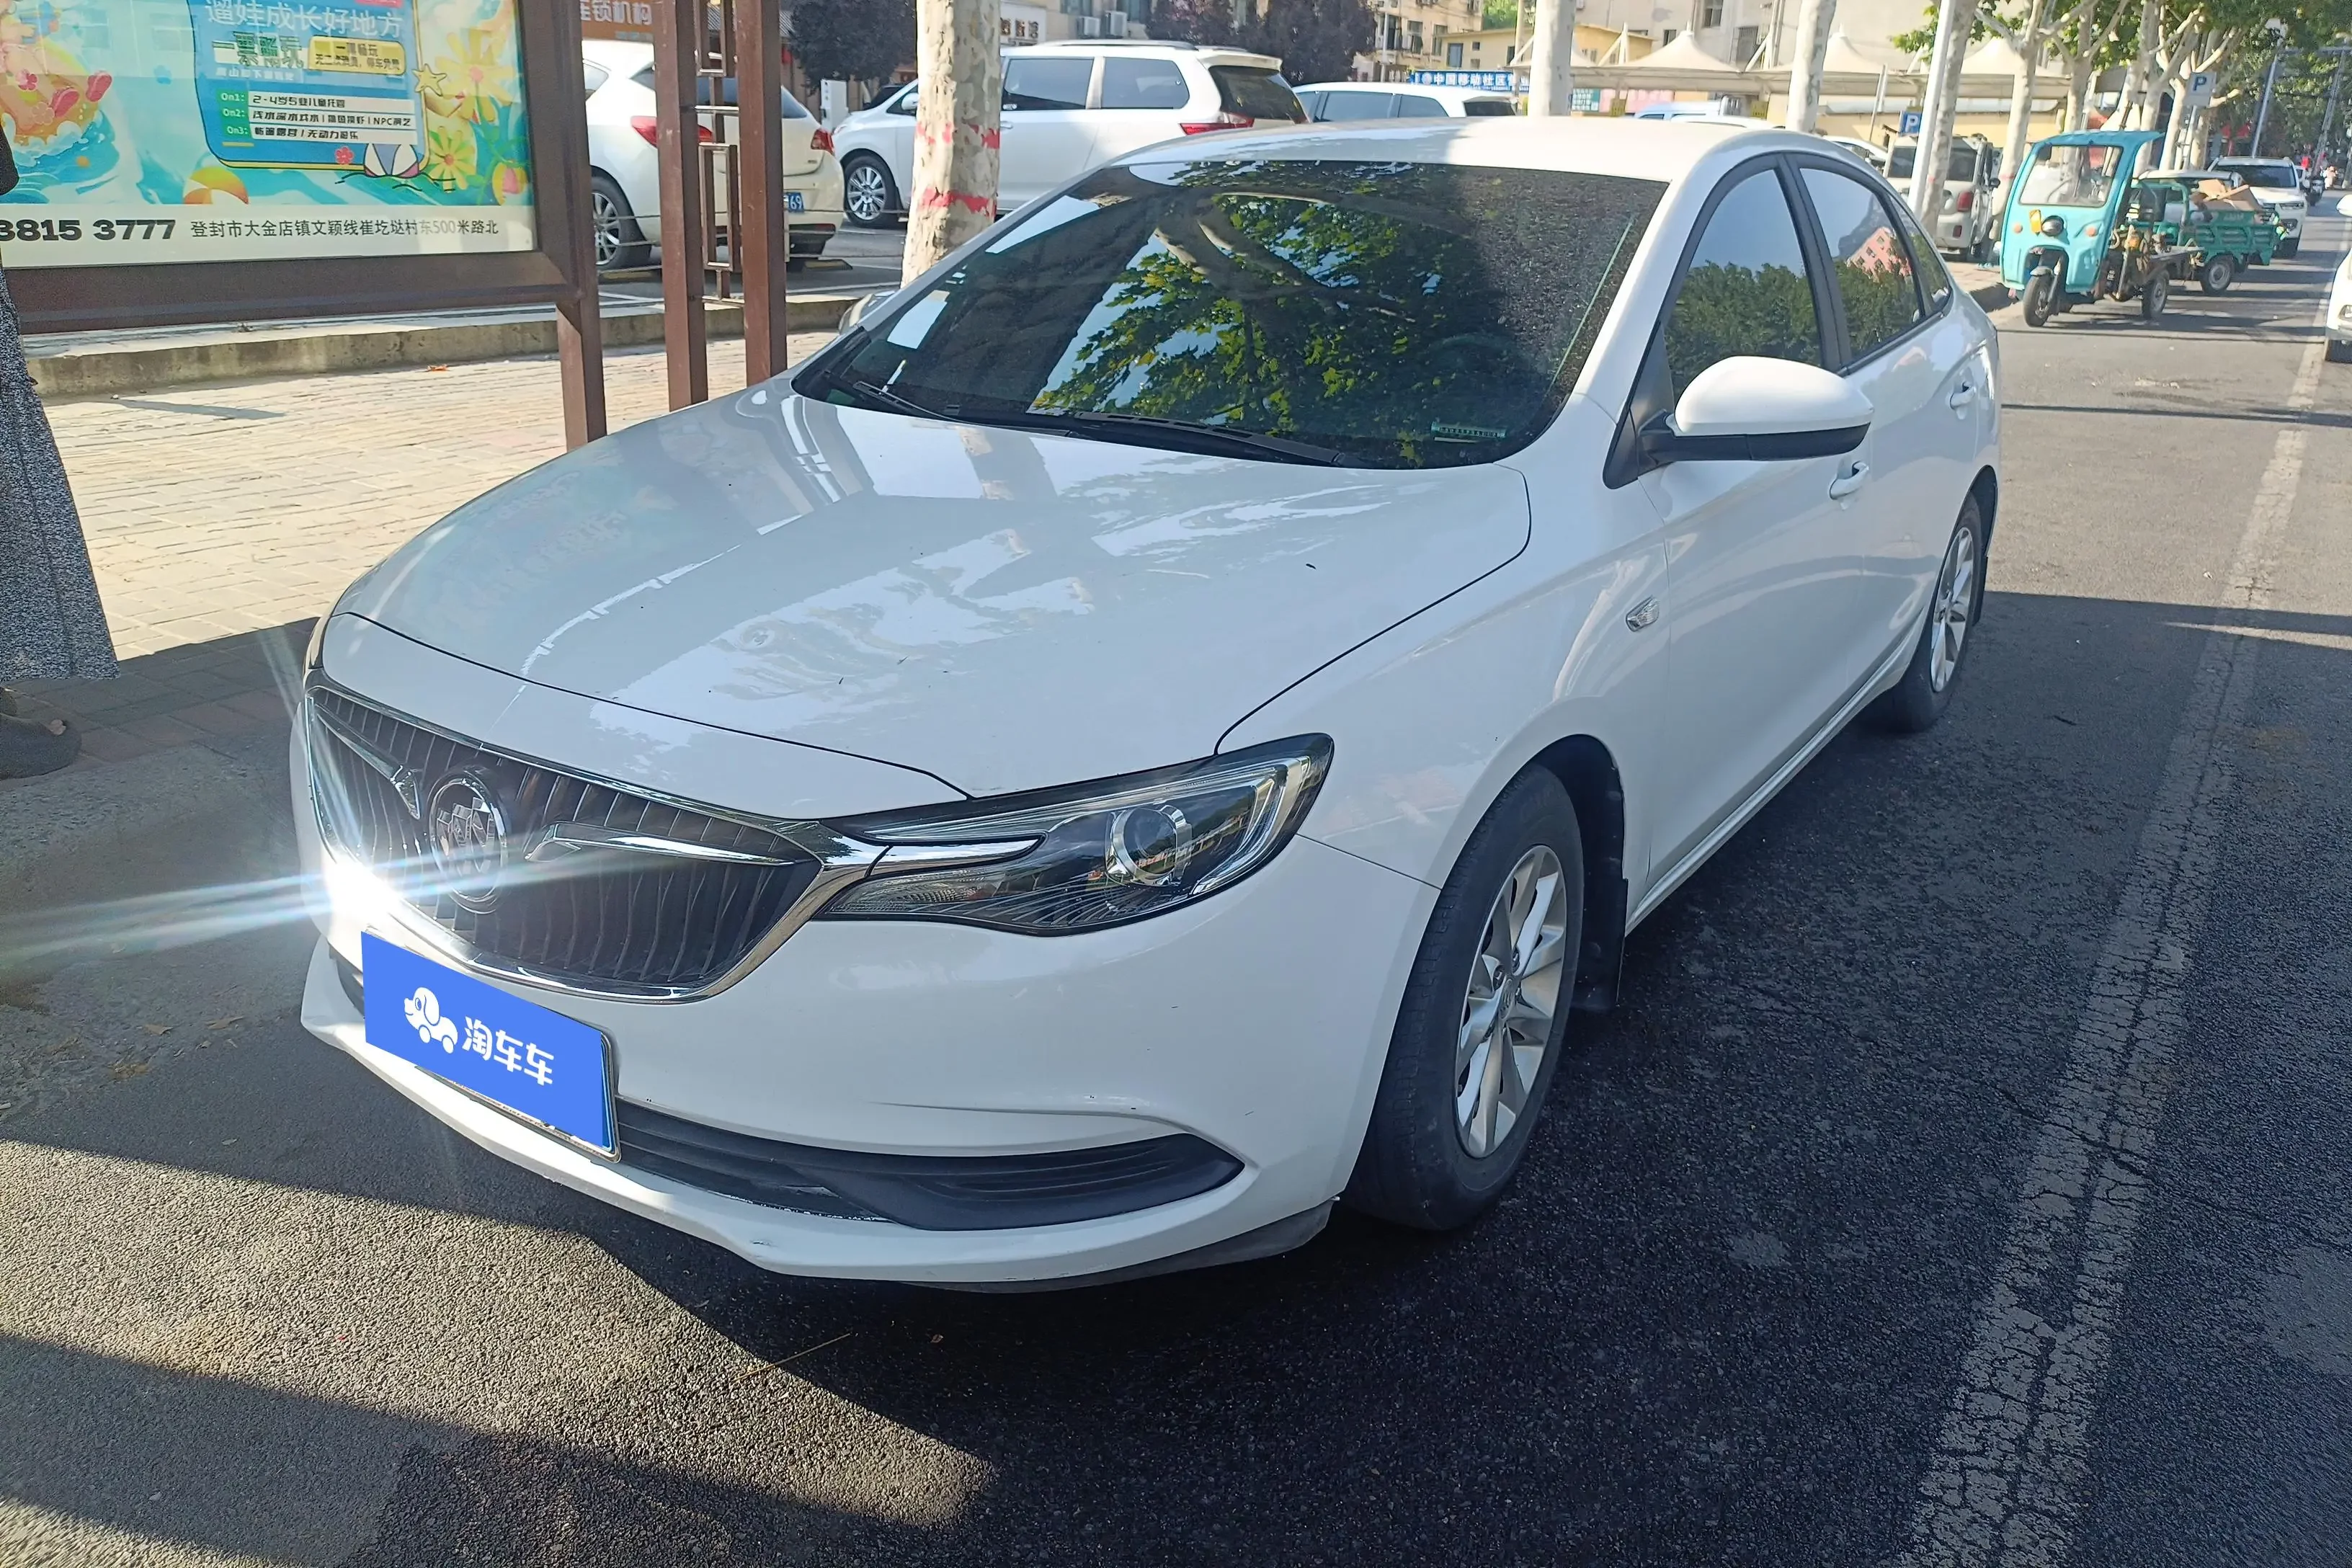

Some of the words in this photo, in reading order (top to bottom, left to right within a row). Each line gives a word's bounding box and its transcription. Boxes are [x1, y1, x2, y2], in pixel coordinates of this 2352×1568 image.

[2193, 76, 2206, 91] P
[1905, 115, 1918, 133] P
[93, 219, 176, 241] 3777
